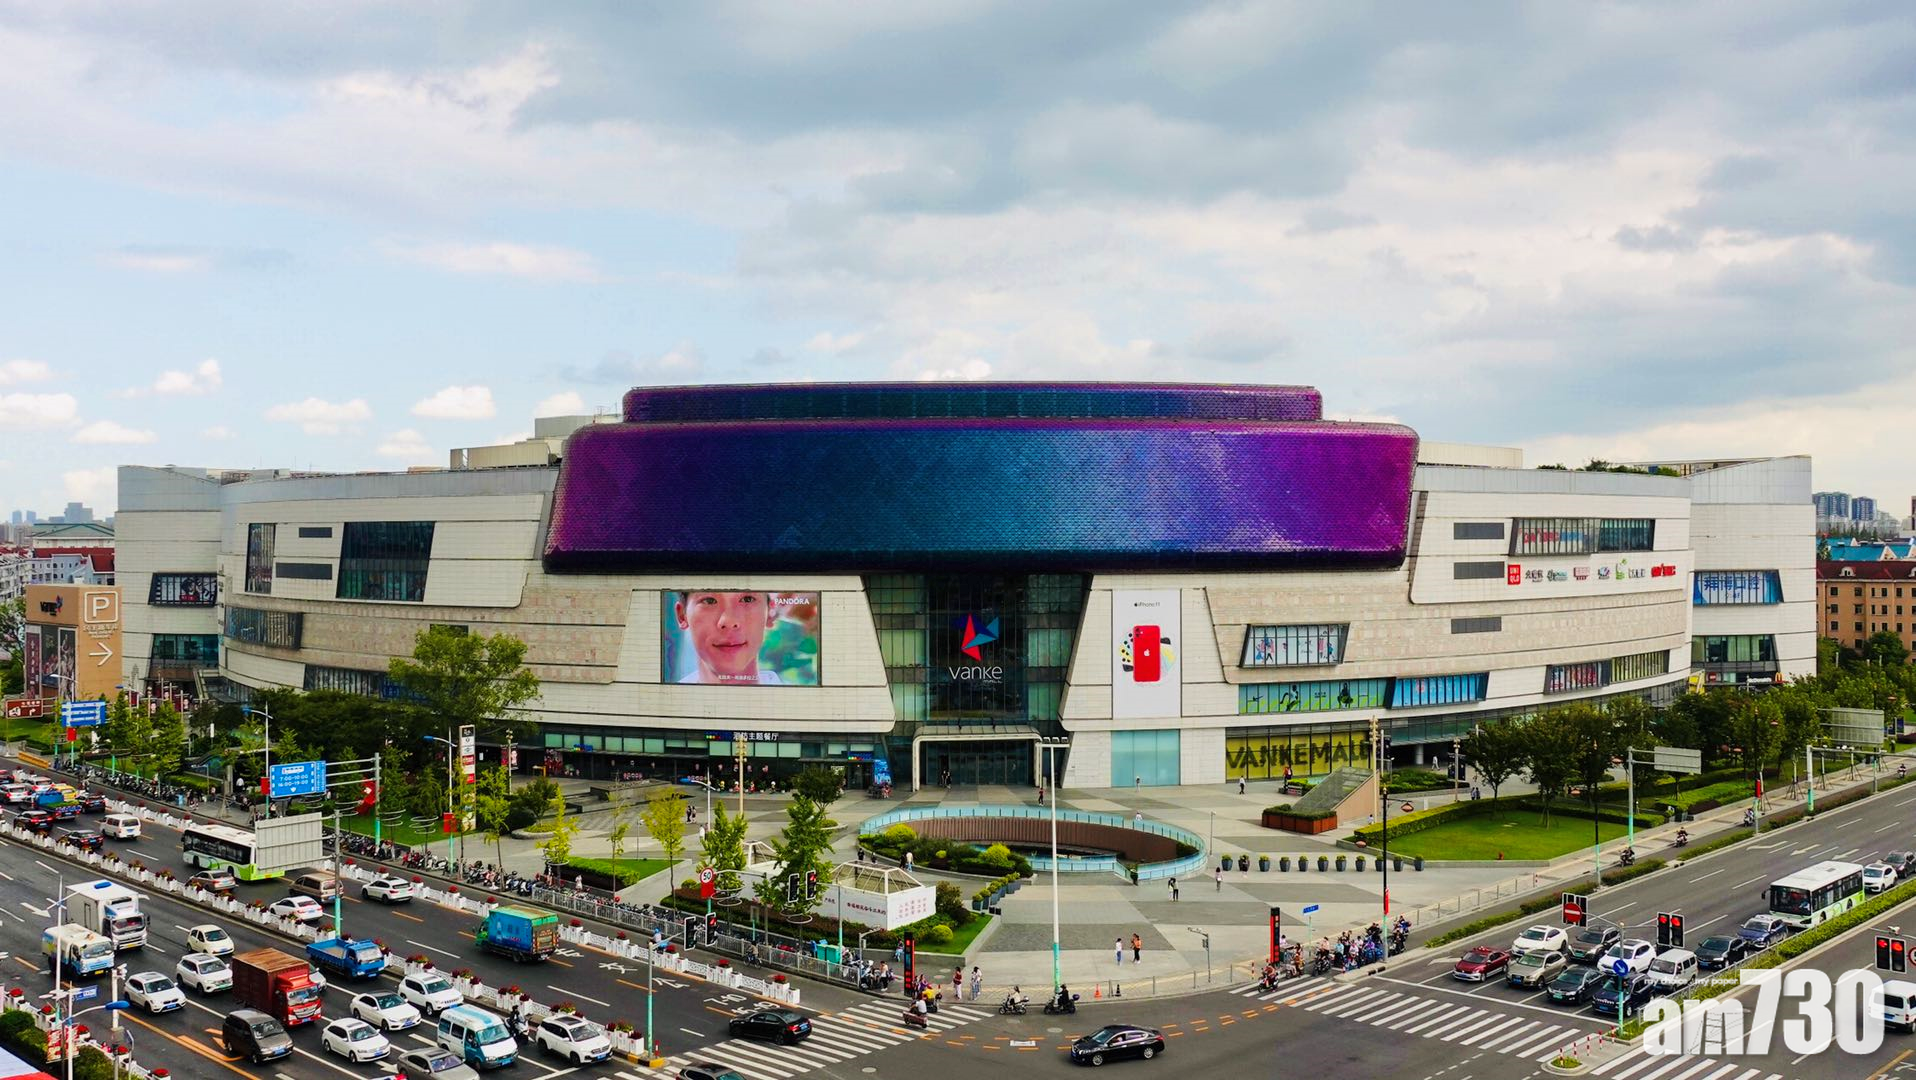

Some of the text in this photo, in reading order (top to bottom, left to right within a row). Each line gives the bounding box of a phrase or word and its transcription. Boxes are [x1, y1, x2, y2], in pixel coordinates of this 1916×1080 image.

[1704, 575, 1760, 591] 拜博口腔
[92, 596, 110, 618] P
[948, 666, 1003, 680] vanke
[703, 871, 711, 881] 50
